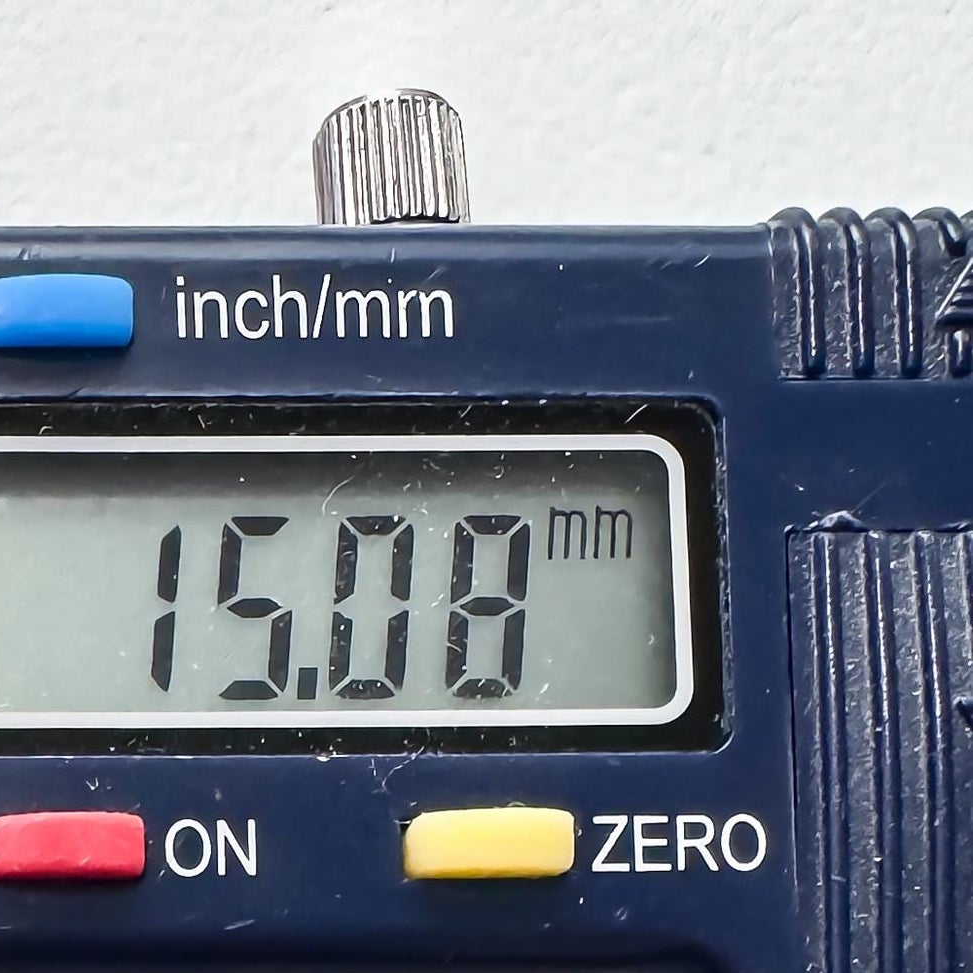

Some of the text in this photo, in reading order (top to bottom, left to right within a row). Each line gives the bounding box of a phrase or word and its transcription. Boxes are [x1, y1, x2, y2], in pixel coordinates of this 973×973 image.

[176, 272, 455, 341] inch/mm
[150, 505, 634, 701] 15.08 mm
[164, 818, 257, 878] ON
[591, 813, 768, 873] ZERO
